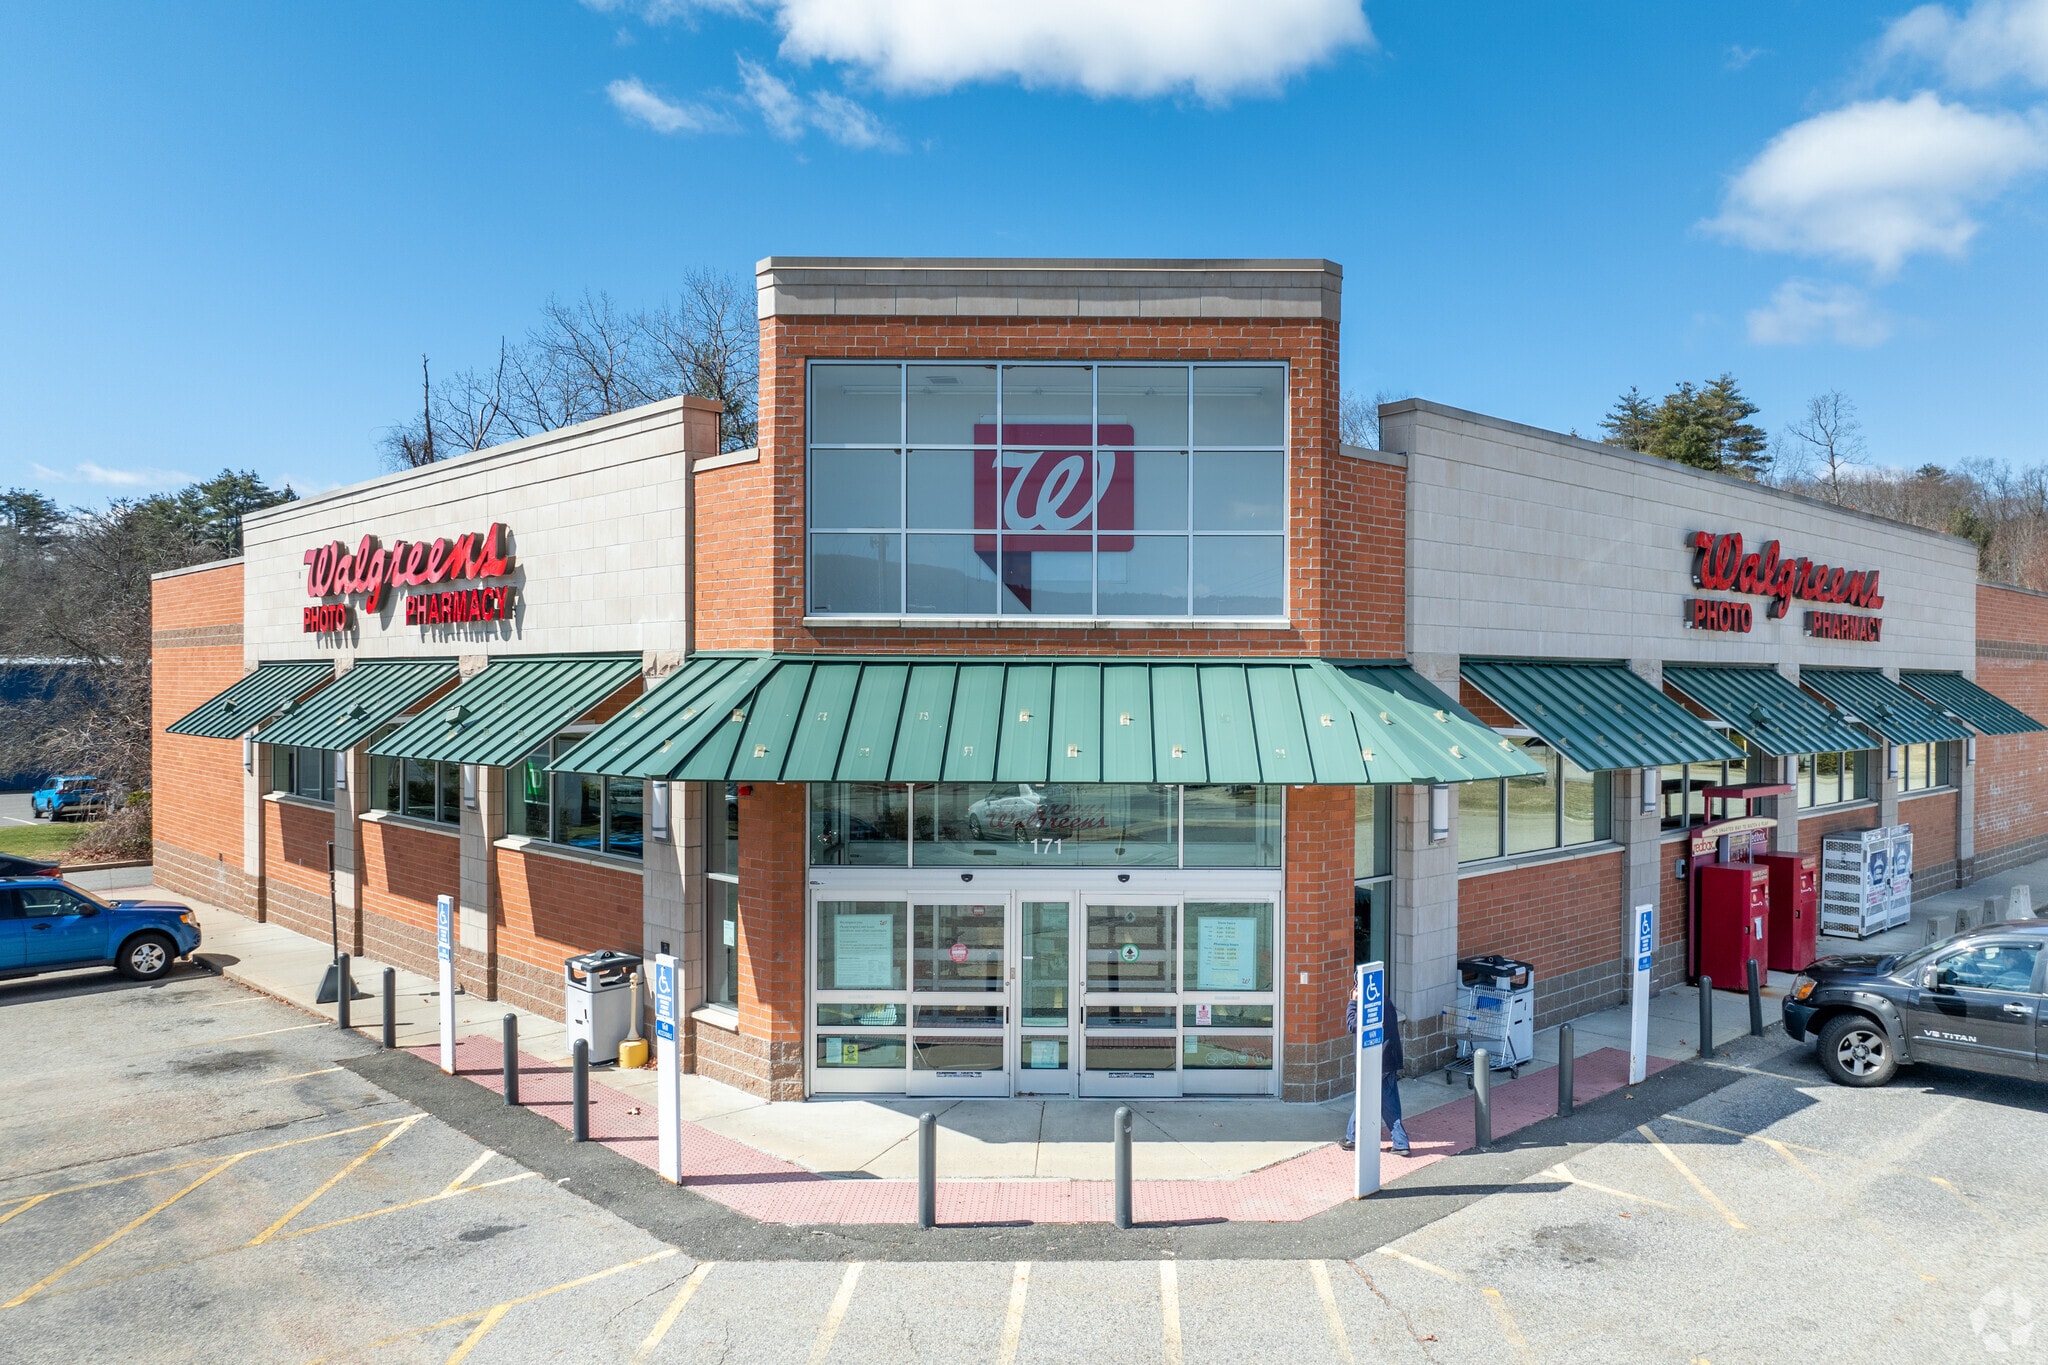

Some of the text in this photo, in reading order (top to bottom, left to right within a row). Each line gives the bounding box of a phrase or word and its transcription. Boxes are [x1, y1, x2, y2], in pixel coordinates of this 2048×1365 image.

[992, 444, 1116, 532] W
[303, 522, 511, 614] Walgreens
[1693, 531, 1885, 619] Walgreens
[303, 585, 511, 633] PHOTO PHARMACY
[1693, 599, 1883, 643] PHOTO PHARMACY
[986, 811, 1110, 834] Walgreens
[1751, 831, 1766, 843] edbox
[1030, 838, 1062, 854] 171
[1693, 838, 1713, 853] redbox
[1942, 1032, 1977, 1042] TITAN
